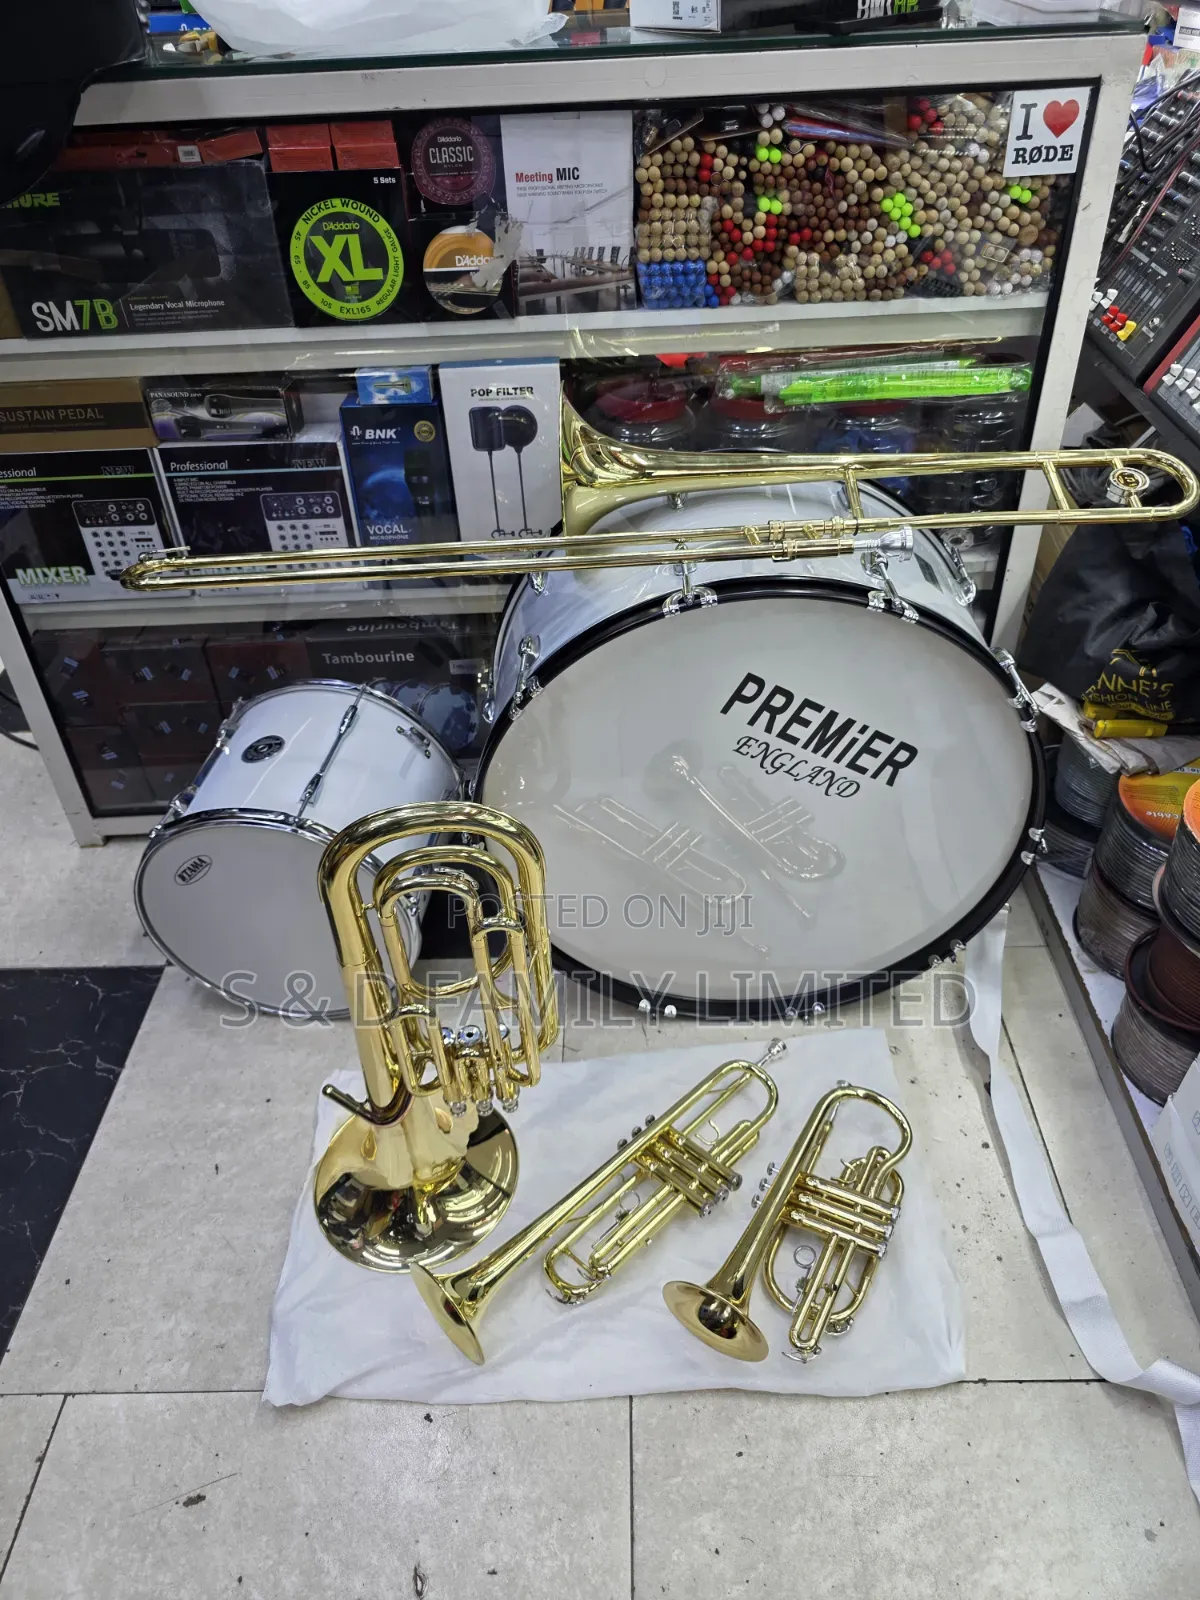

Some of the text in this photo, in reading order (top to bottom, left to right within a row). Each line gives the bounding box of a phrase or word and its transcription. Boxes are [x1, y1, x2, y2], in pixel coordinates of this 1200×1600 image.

[1016, 103, 1038, 141] I
[428, 146, 474, 164] CLASSIC
[1012, 144, 1074, 165] RØDE
[380, 176, 396, 184] Sets
[515, 167, 580, 183] Meeting MIC
[302, 198, 380, 225] NICKEL WOUND
[322, 222, 360, 231] D'Addario
[384, 228, 398, 253] GAUGE
[309, 234, 384, 283] XL
[376, 278, 397, 306] REGULAR
[129, 299, 225, 311] Legendary Vocal Microphone
[340, 305, 371, 314] EXL165
[31, 299, 118, 332] SM7B
[470, 386, 534, 397] POP FILTER
[0, 408, 104, 423] SUSTAIN PEDAL
[365, 428, 397, 439] BNK
[170, 460, 228, 471] Professional
[292, 459, 326, 469] NEW
[367, 525, 408, 535] VOCAL
[15, 566, 88, 587] MIXER
[322, 651, 415, 665] Tambourine
[733, 736, 861, 798] ENGLAND
[181, 858, 207, 879] TAMA
